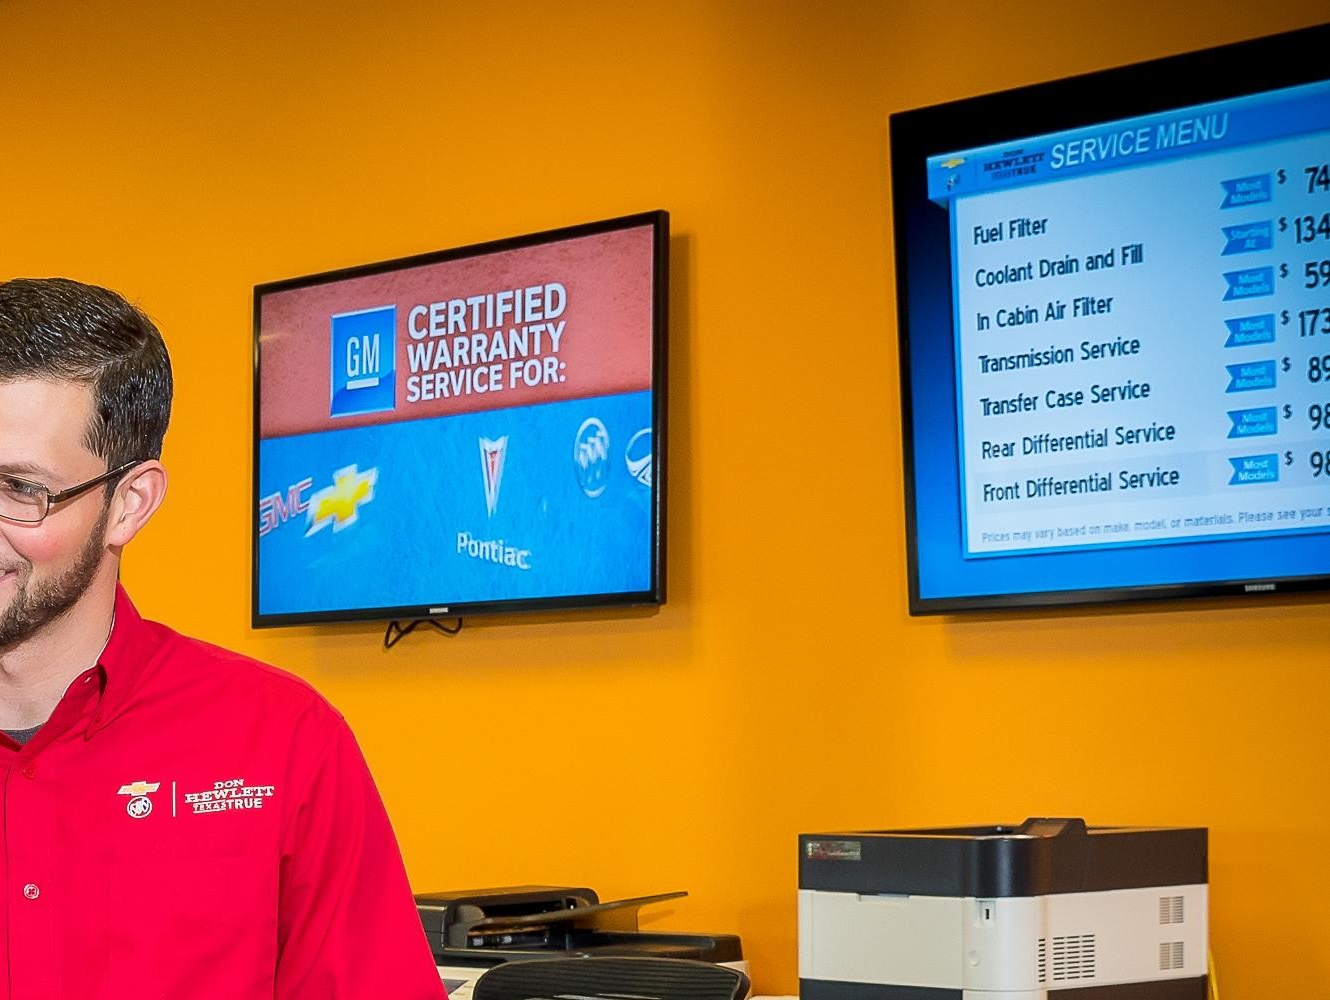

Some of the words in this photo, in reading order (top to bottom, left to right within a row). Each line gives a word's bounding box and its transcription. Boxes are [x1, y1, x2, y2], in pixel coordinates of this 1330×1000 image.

[1050, 126, 1151, 169] SERVICE
[1156, 112, 1229, 150] MENU
[973, 222, 1003, 245] Fuel
[1009, 218, 1048, 239] Filter
[975, 262, 1033, 287] Coolant
[1039, 254, 1079, 278] Drain
[1085, 248, 1114, 271] and
[1121, 243, 1143, 265] Fill
[407, 281, 567, 341] CERTIFIED
[977, 312, 990, 331] In
[996, 305, 1038, 328] Cabin
[1044, 301, 1067, 322] Air
[1073, 297, 1113, 318] Filter
[346, 334, 380, 378] GM
[406, 320, 567, 374] WARRANTY
[978, 345, 1074, 373] Transmission
[1080, 336, 1141, 361] Service
[406, 363, 503, 403] SERVICE
[509, 358, 567, 389] FOR:
[979, 393, 1038, 416] Transfer
[1045, 390, 1084, 409] Case
[1090, 380, 1151, 404] Service
[981, 440, 1016, 459] Rear
[1022, 428, 1108, 456] Differential
[1115, 422, 1176, 446] Service
[983, 481, 1020, 502] Front
[1026, 472, 1112, 498] Differential
[1119, 467, 1180, 490] Service
[1057, 525, 1087, 538] based
[1088, 525, 1101, 535] on
[1238, 511, 1273, 524] Please
[1277, 509, 1296, 520] see
[1299, 506, 1323, 521] your
[457, 531, 532, 570] Pontiac
[184, 785, 275, 803] HEWLETT
[213, 778, 244, 790] DON
